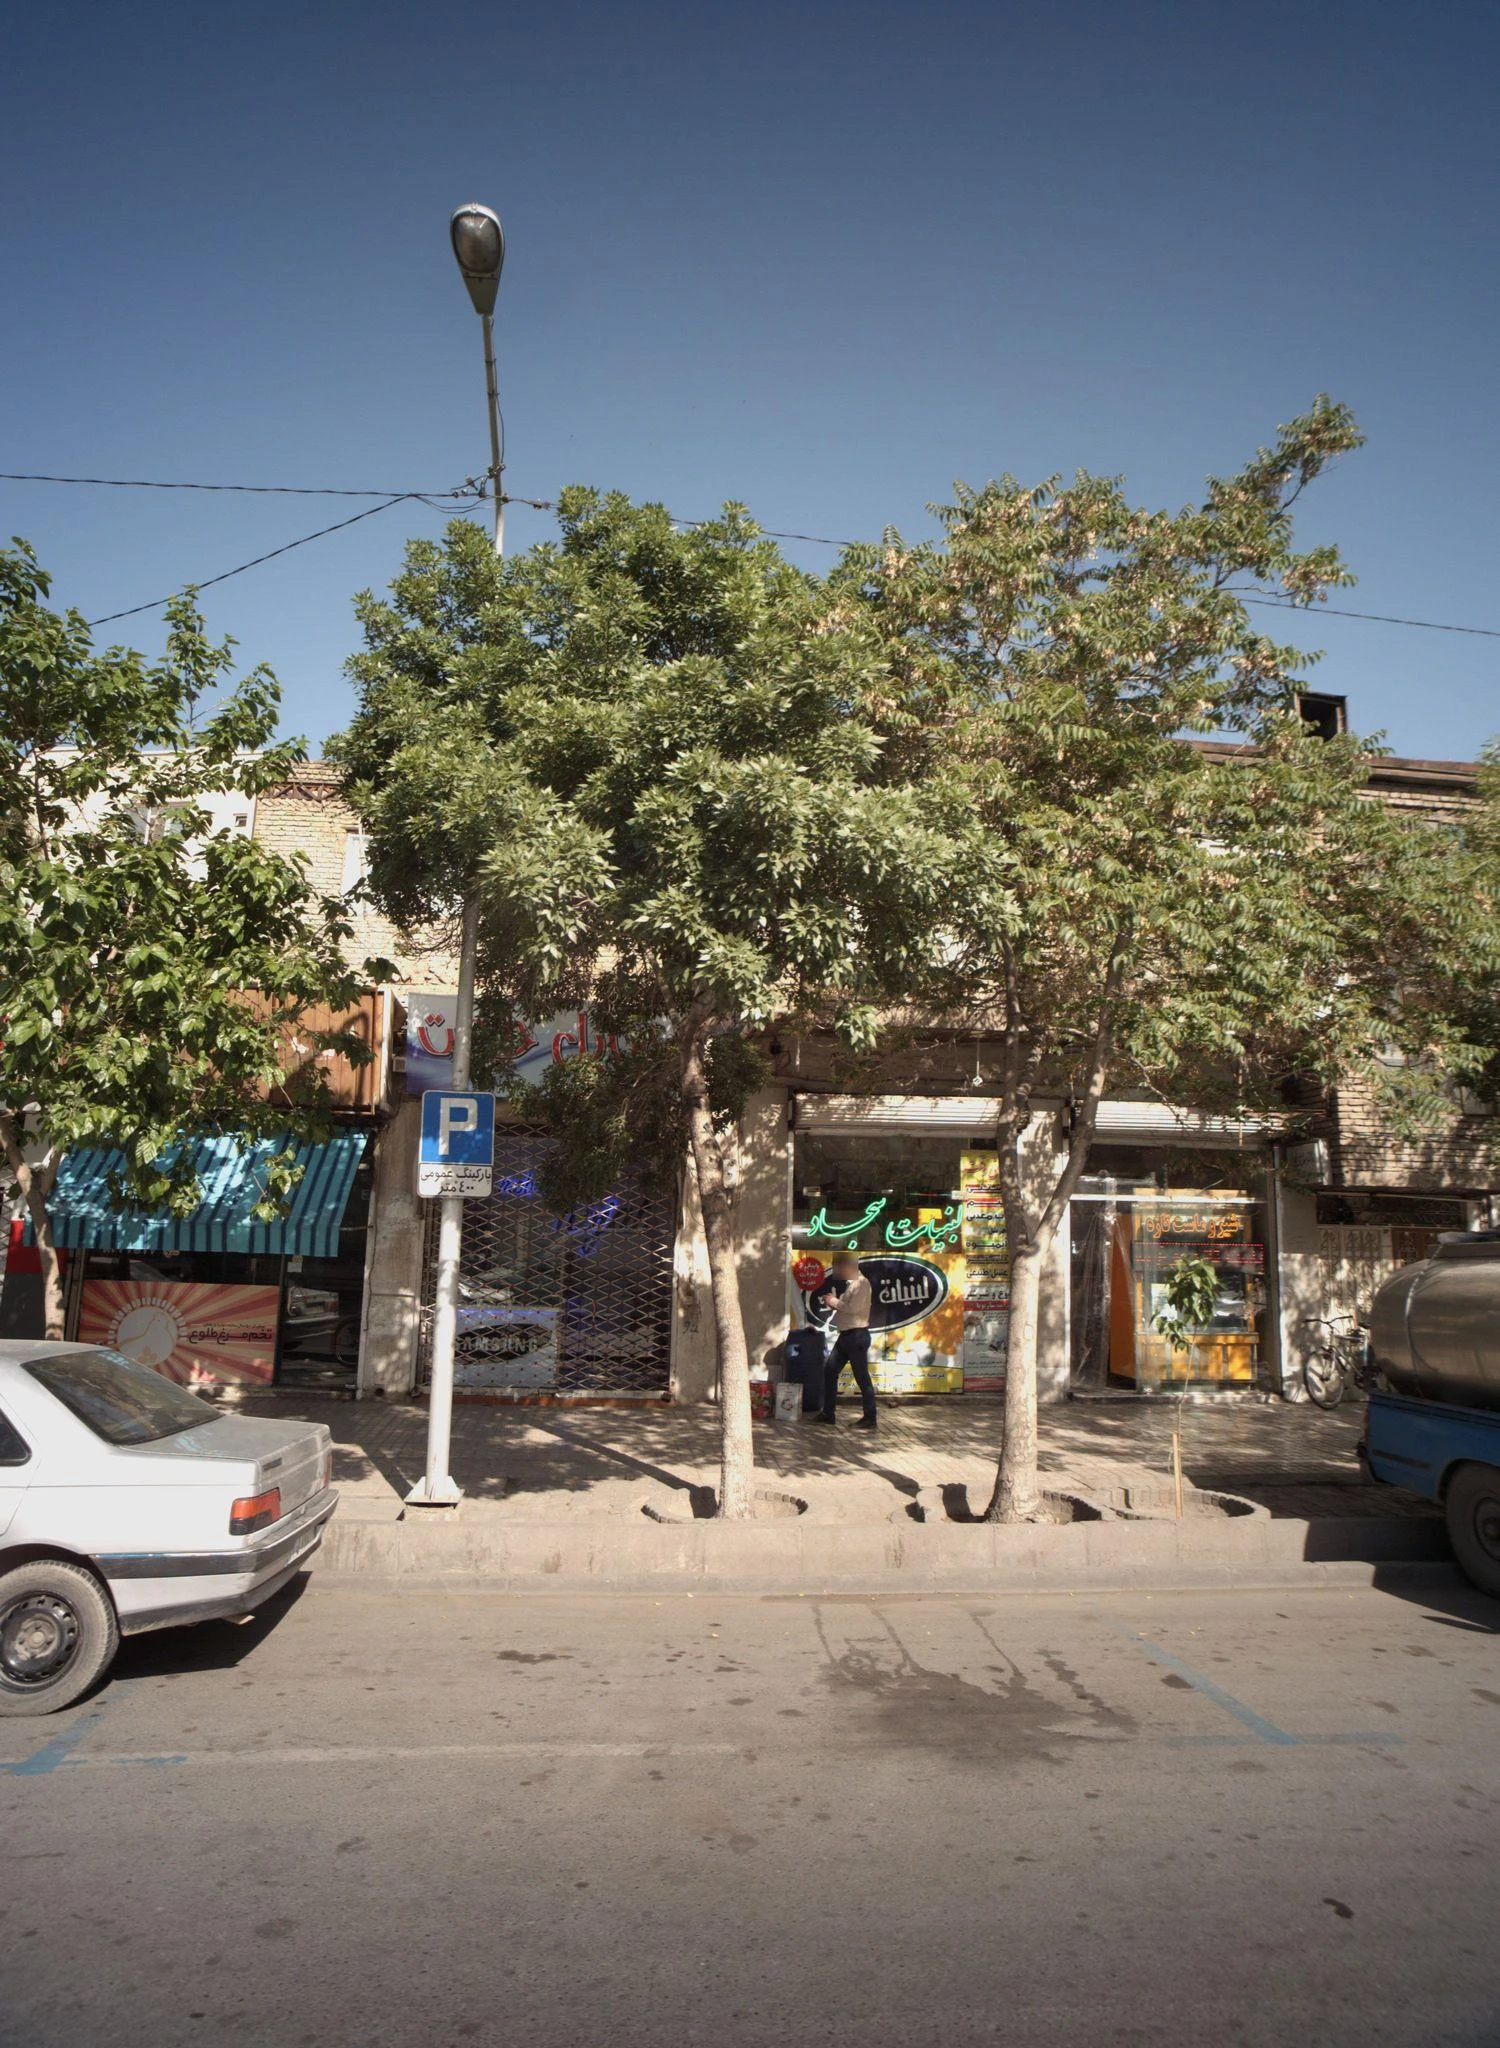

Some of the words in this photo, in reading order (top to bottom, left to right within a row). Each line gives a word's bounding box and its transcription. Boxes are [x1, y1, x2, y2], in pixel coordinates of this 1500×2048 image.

[439, 1097, 478, 1156] P
[420, 1170, 454, 1181] عمومی
[456, 1166, 492, 1185] پارکینگ
[438, 1183, 457, 1195] متر
[807, 1197, 887, 1249] سجاد
[966, 1210, 993, 1222] معدنی
[1172, 1213, 1207, 1233] ماست
[1217, 1212, 1241, 1239] شیر
[886, 1204, 963, 1252] لبنیات
[1146, 1213, 1172, 1239] تازه
[1207, 1219, 1217, 1239] و
[879, 1275, 929, 1305] لبنیات
[997, 1286, 1010, 1300] وغ
[189, 1328, 218, 1344] طلوع
[217, 1326, 249, 1345] مرغ
[248, 1329, 273, 1342] تخم
